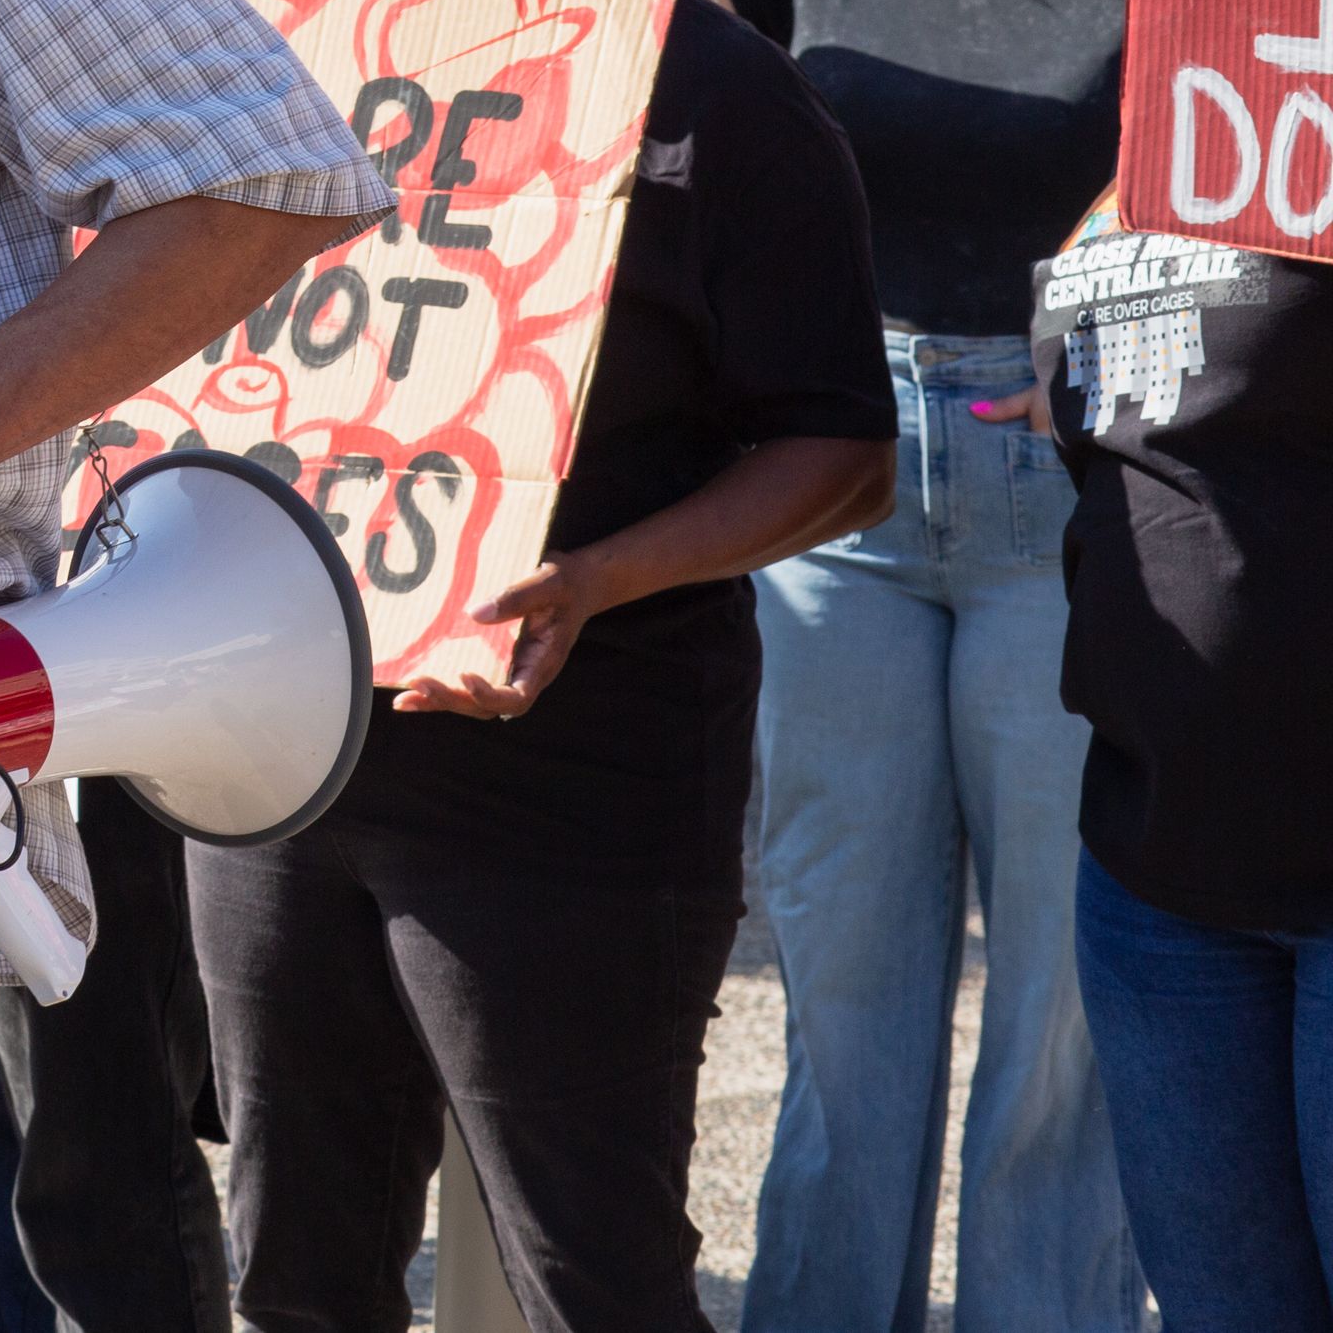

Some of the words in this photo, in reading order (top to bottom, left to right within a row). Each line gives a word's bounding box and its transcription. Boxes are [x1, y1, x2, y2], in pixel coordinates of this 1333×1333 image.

[351, 75, 523, 251] RE
[1045, 258, 1166, 311] CENTRAL
[1170, 250, 1241, 285] JAIL
[1052, 236, 1142, 278] CLOSE
[202, 264, 469, 383] NOT
[1077, 305, 1112, 327] CARE
[1114, 299, 1150, 321] OVER
[1151, 291, 1195, 314] CAGES
